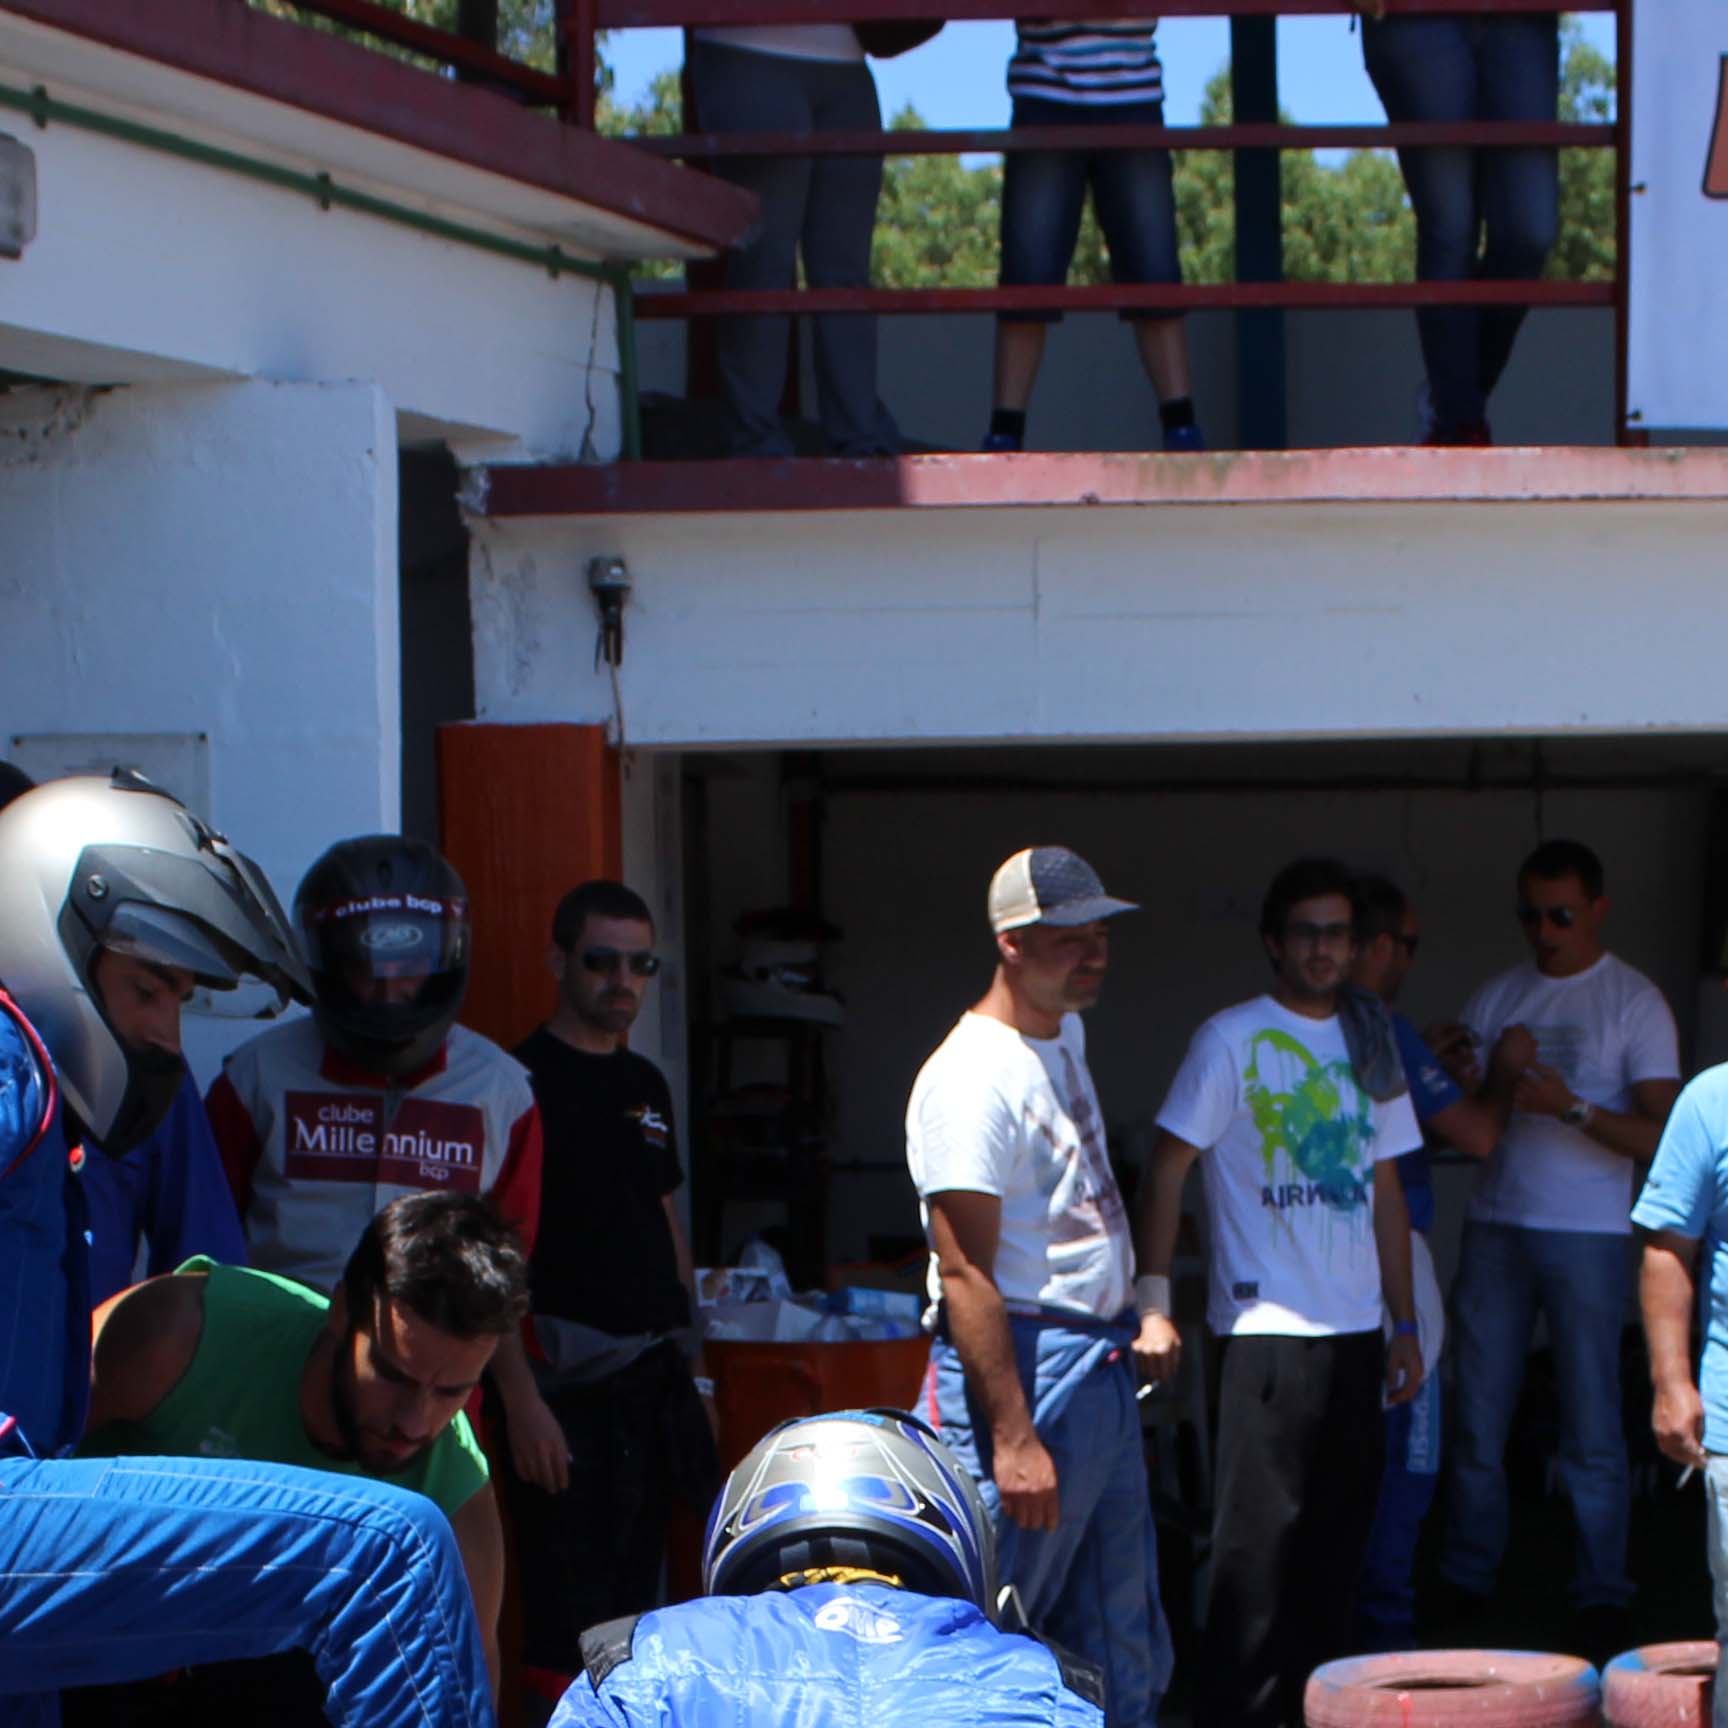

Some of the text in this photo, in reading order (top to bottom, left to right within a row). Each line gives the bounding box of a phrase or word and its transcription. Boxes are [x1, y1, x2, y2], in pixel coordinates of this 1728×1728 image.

[318, 1103, 373, 1122] clube
[293, 1116, 473, 1164] Millennium
[419, 1160, 449, 1180] bcp
